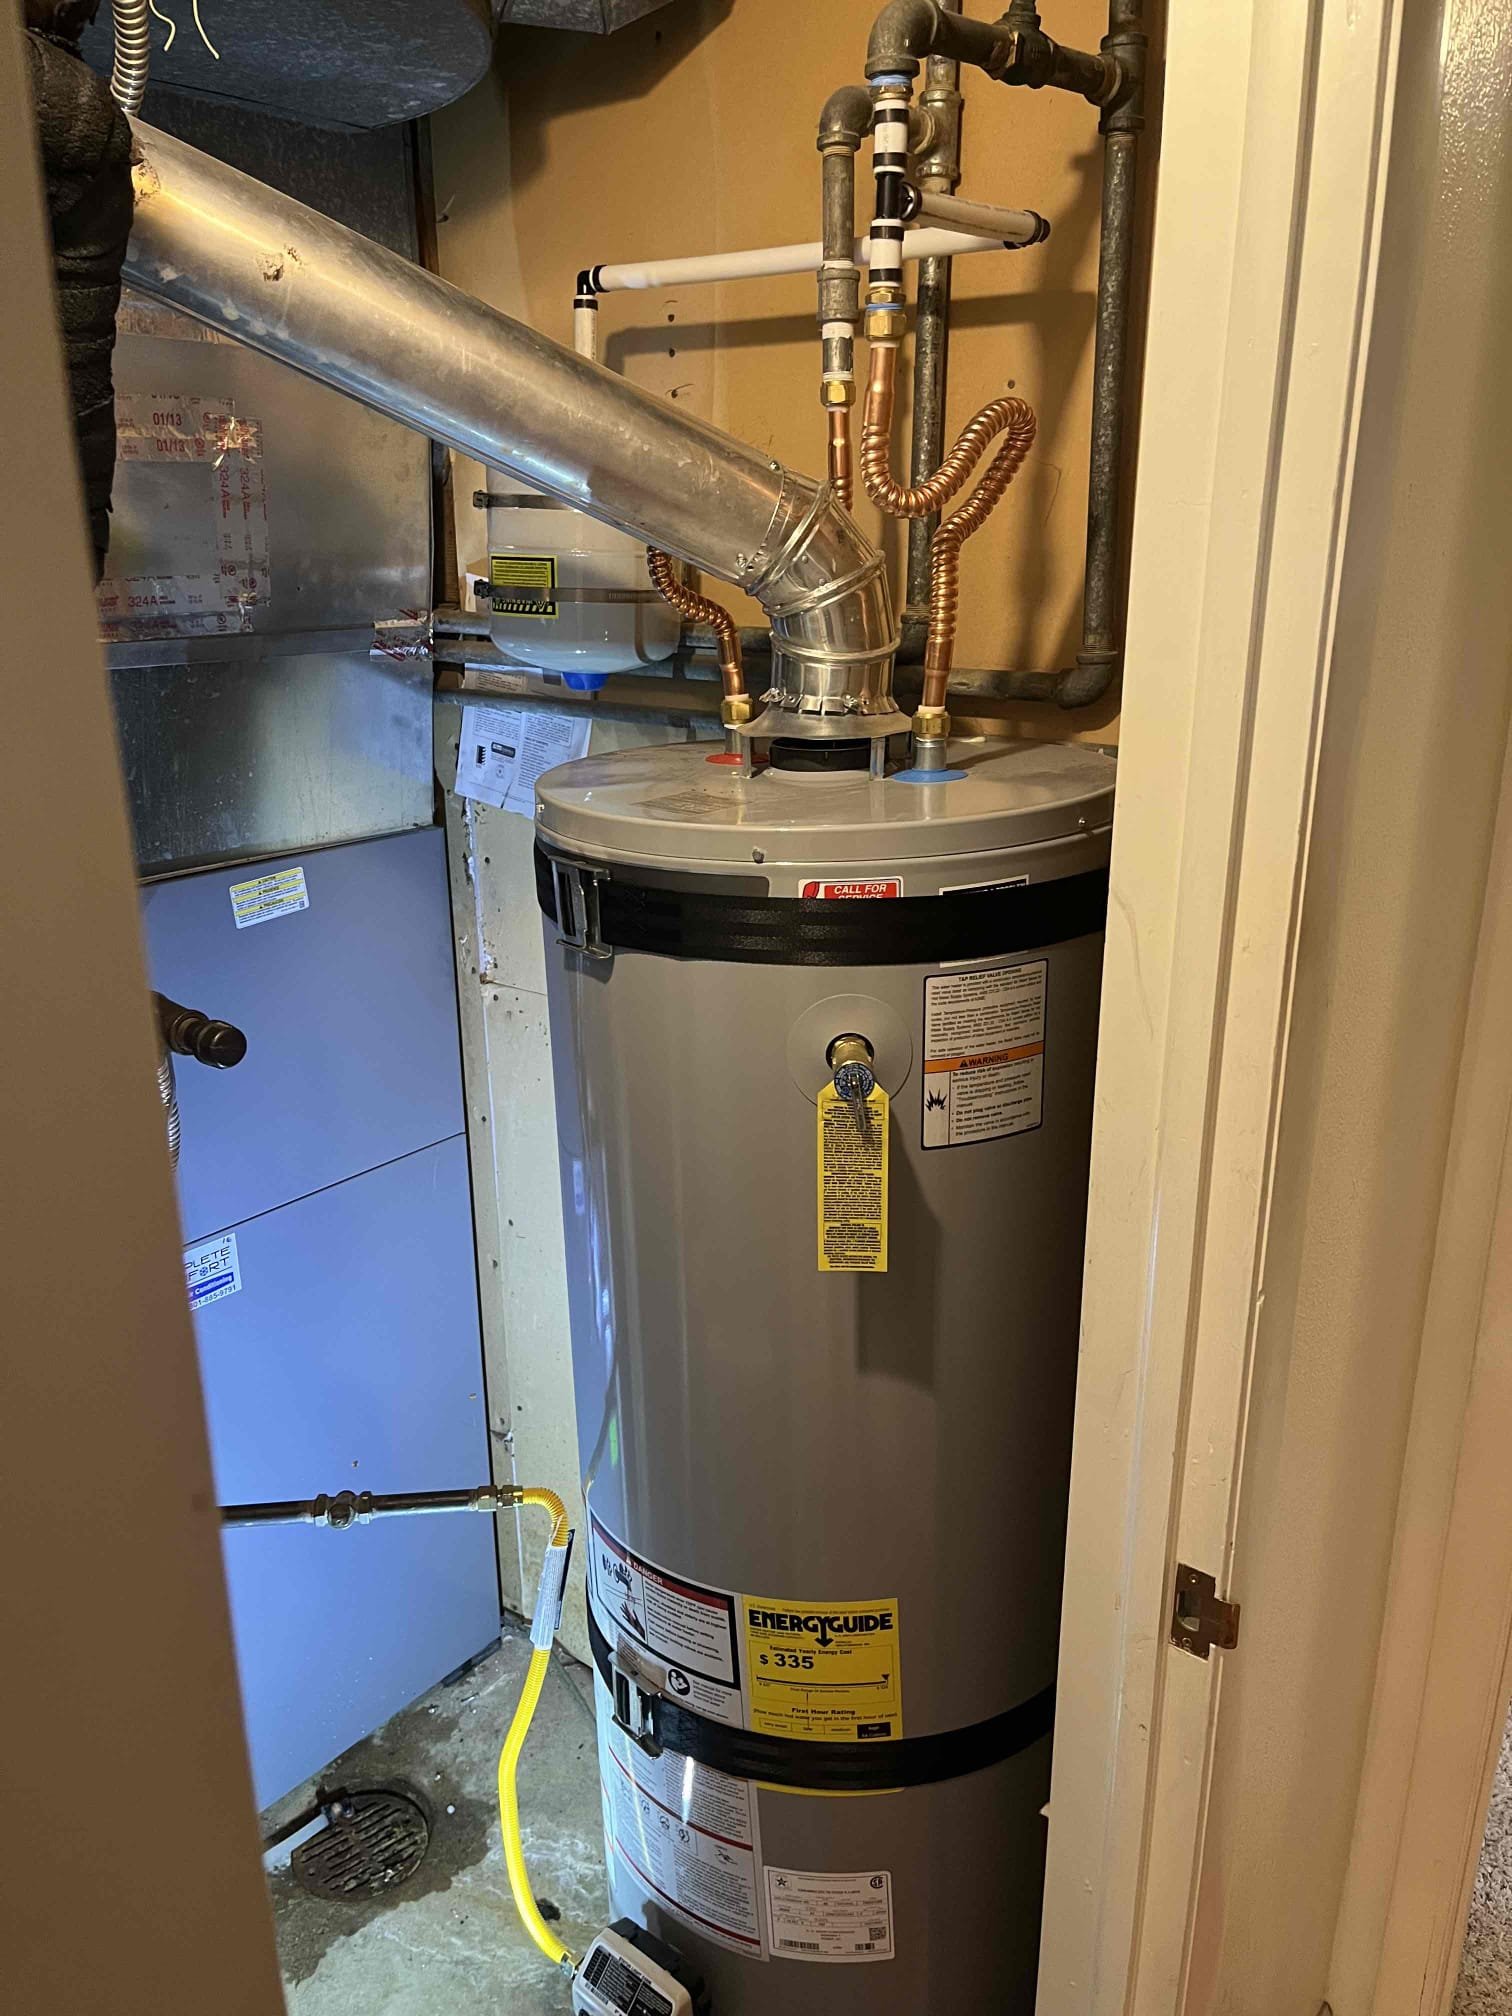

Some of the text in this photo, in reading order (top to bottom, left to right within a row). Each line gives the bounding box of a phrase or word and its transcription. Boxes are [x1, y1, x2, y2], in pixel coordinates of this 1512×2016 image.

[153, 413, 181, 426] 01/13
[157, 438, 185, 451] 01/13
[219, 467, 230, 499] 324A
[239, 468, 251, 500] 324A
[128, 596, 159, 607] 324A
[834, 884, 887, 894] CALL FOR
[969, 1054, 1008, 1066] WARNING
[633, 1562, 663, 1585] DANGER
[749, 1609, 893, 1634] ENERGYGUIDE
[759, 1653, 814, 1669] $ 335
